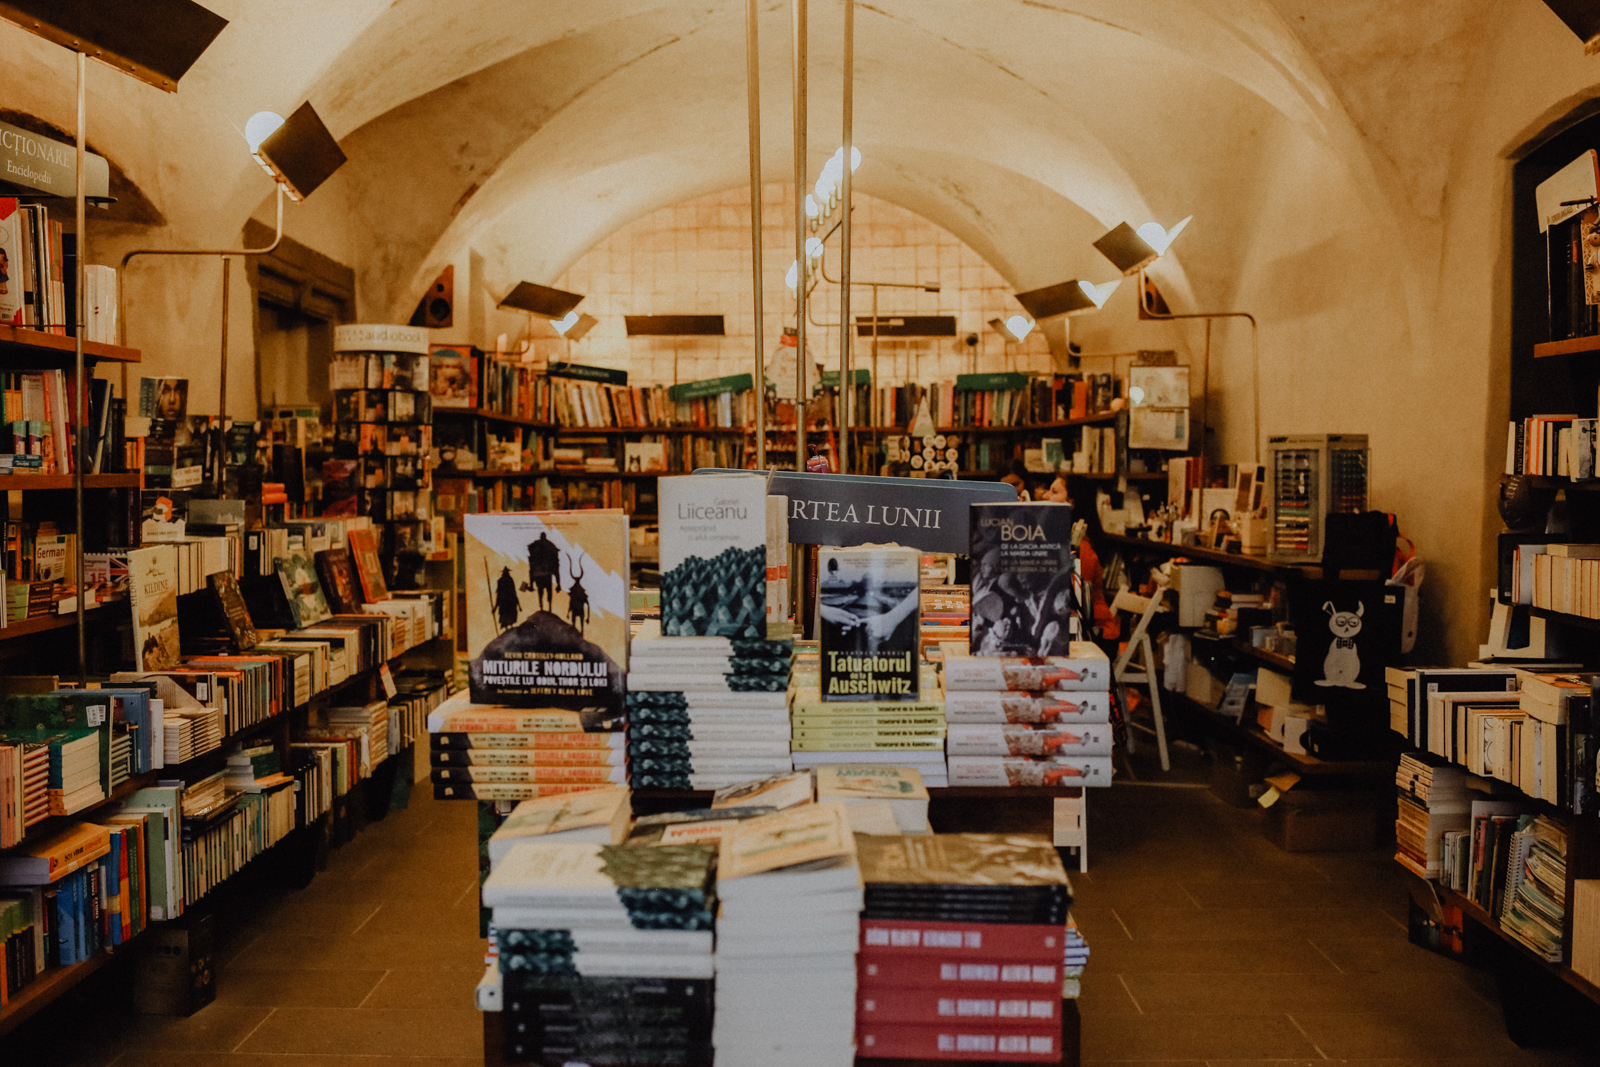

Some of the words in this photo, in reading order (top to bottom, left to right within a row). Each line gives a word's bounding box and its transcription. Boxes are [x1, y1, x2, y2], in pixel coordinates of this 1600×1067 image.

[7, 160, 52, 184] Enciclopedii
[678, 503, 747, 520] Liiceanu
[787, 500, 860, 524] RTEA
[866, 505, 942, 529] LUNII
[1001, 525, 1047, 541] BOIA
[37, 548, 65, 559] German
[90, 572, 108, 583] 15
[143, 579, 169, 595] KILDINE
[483, 660, 540, 675] MITURILE
[544, 661, 608, 677] NORDULUI
[828, 651, 911, 672] Tatuatorul
[558, 677, 579, 686] THOR
[589, 678, 608, 687] LOKI
[828, 672, 911, 694] Auschwitz
